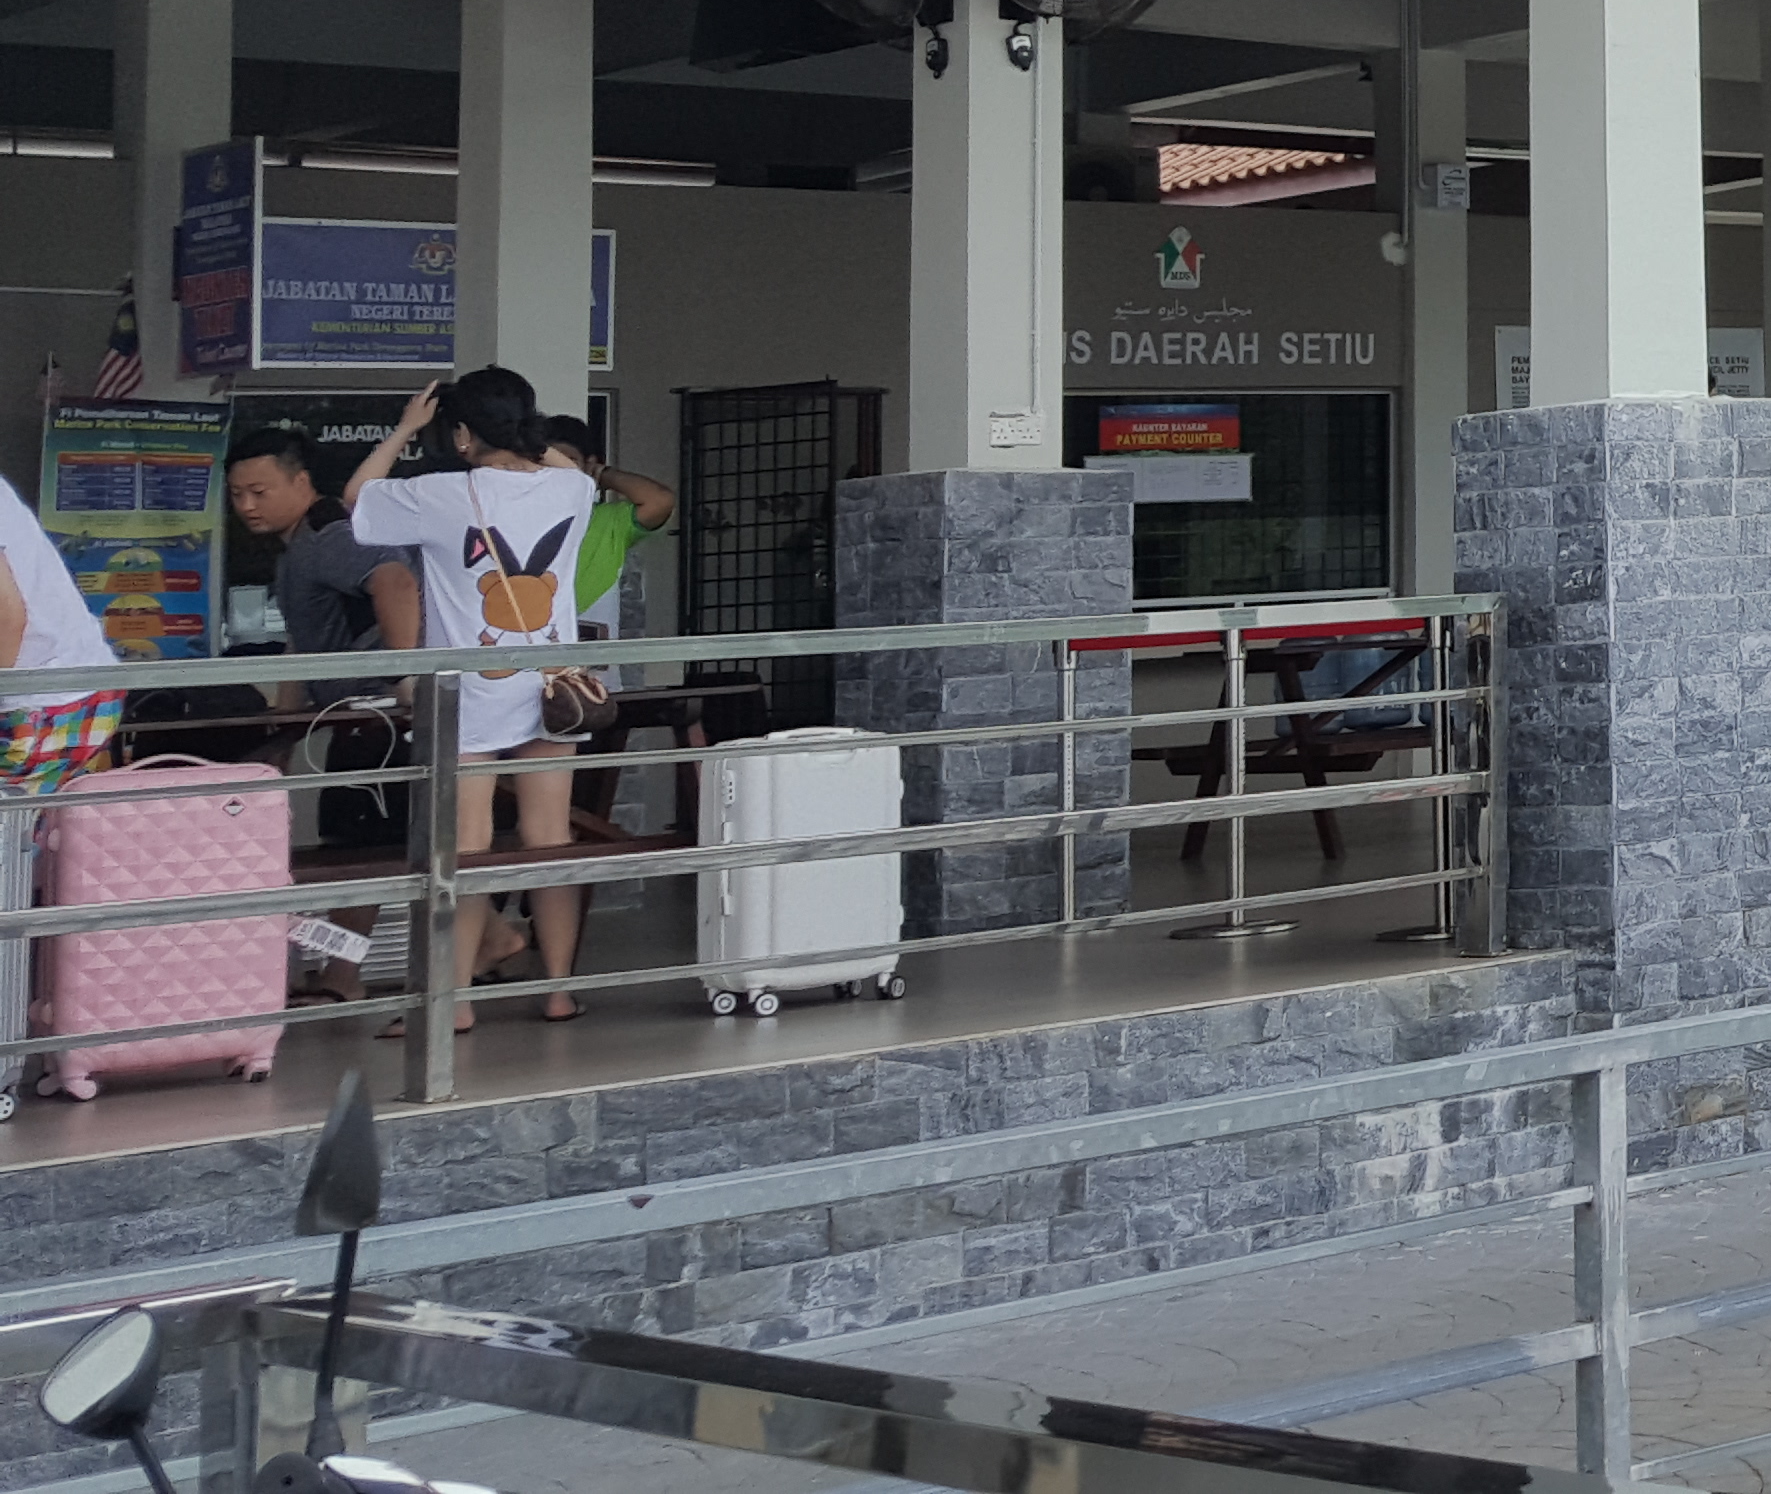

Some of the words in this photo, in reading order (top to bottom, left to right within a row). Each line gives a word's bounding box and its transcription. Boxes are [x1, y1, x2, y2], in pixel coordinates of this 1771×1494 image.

[262, 279, 357, 301] JABATAN
[362, 282, 436, 303] TAMAN
[440, 283, 455, 303] L
[351, 304, 409, 320] NEGERI
[413, 305, 455, 321] TERE
[1110, 331, 1259, 365] DAERAH
[1279, 332, 1375, 365] SETIU
[1511, 356, 1530, 364] PEM
[1511, 366, 1530, 374] MAJ
[1511, 376, 1530, 384] BAY
[1116, 433, 1169, 445] PAYMENT
[1172, 433, 1223, 444] COUNTER
